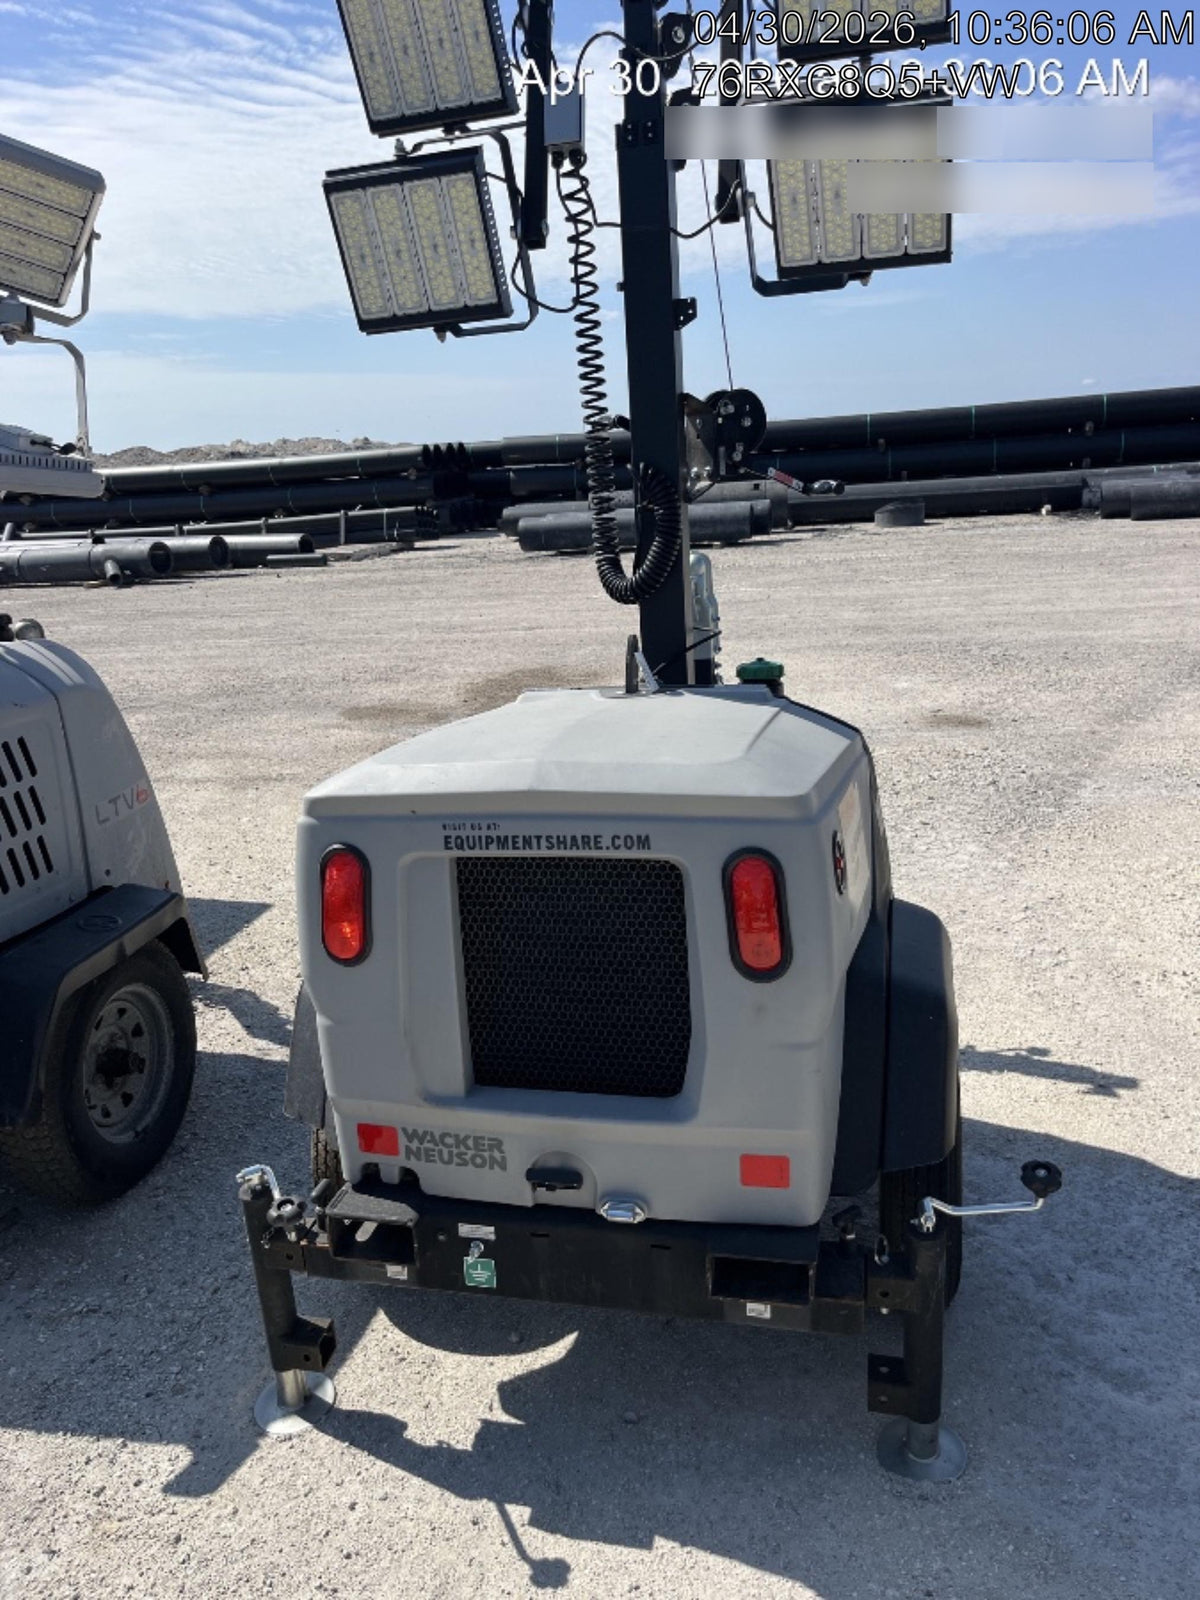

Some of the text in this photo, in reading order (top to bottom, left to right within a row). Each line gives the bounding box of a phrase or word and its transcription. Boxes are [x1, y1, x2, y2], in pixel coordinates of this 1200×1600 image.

[443, 834, 651, 852] EQUIPMENTSHARE.COM
[401, 1126, 505, 1154] WACKER
[404, 1144, 507, 1172] NEUSON
